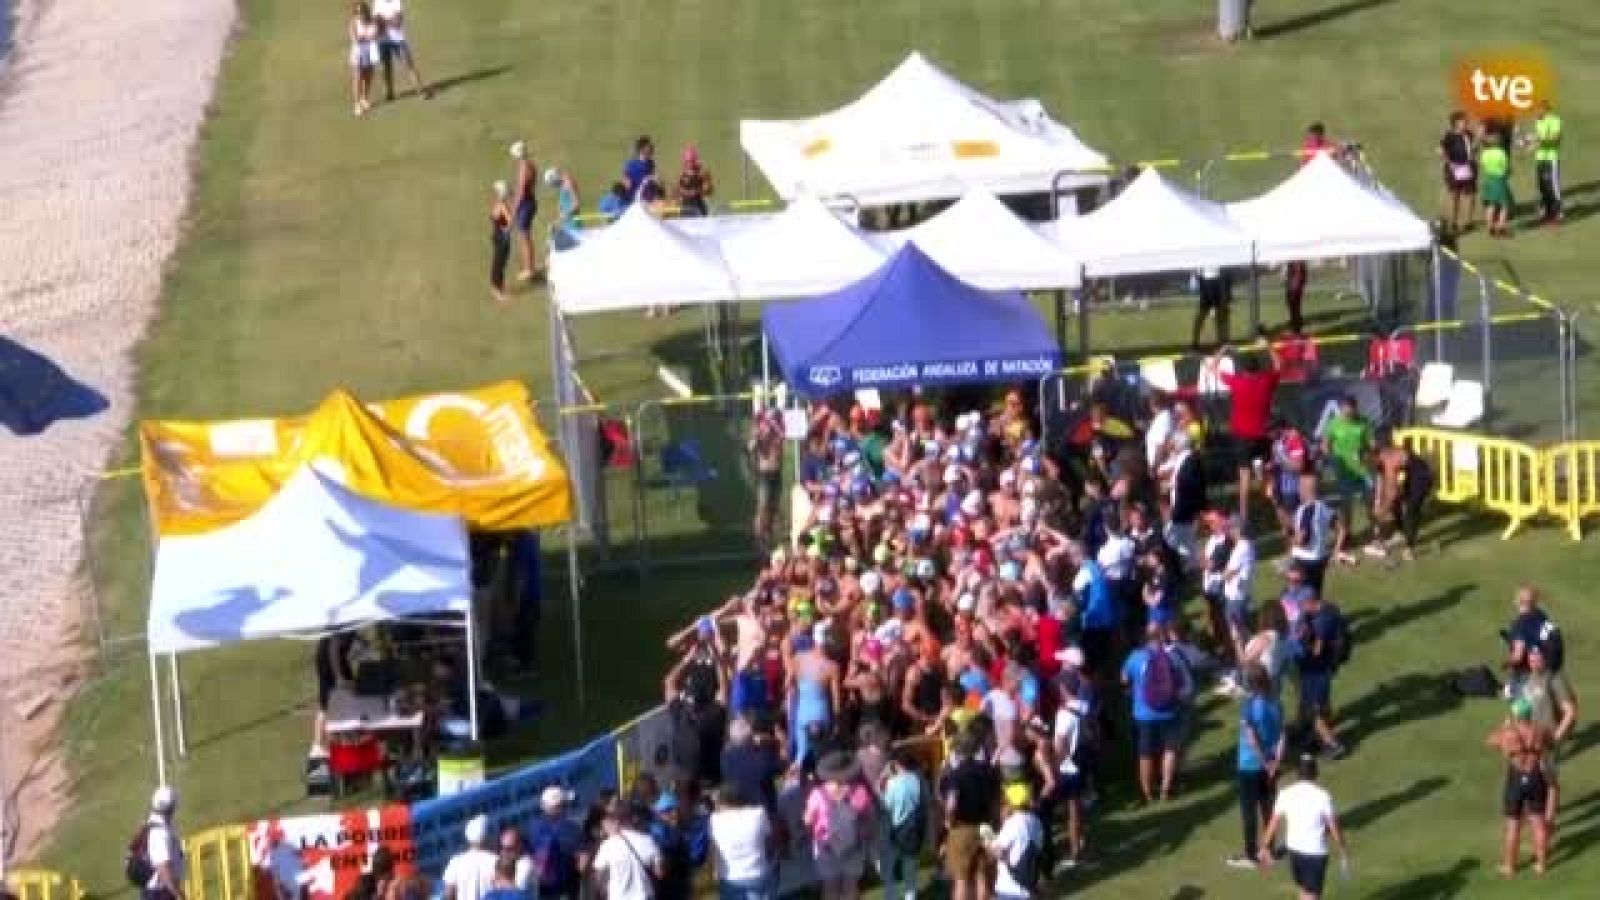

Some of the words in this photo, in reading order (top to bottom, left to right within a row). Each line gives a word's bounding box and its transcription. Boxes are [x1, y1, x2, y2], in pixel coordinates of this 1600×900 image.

[852, 363, 918, 383] FEDERACIÓN
[922, 360, 978, 377] ANDALUZA
[984, 359, 998, 376] DE
[1001, 358, 1054, 373] NATACIÓN
